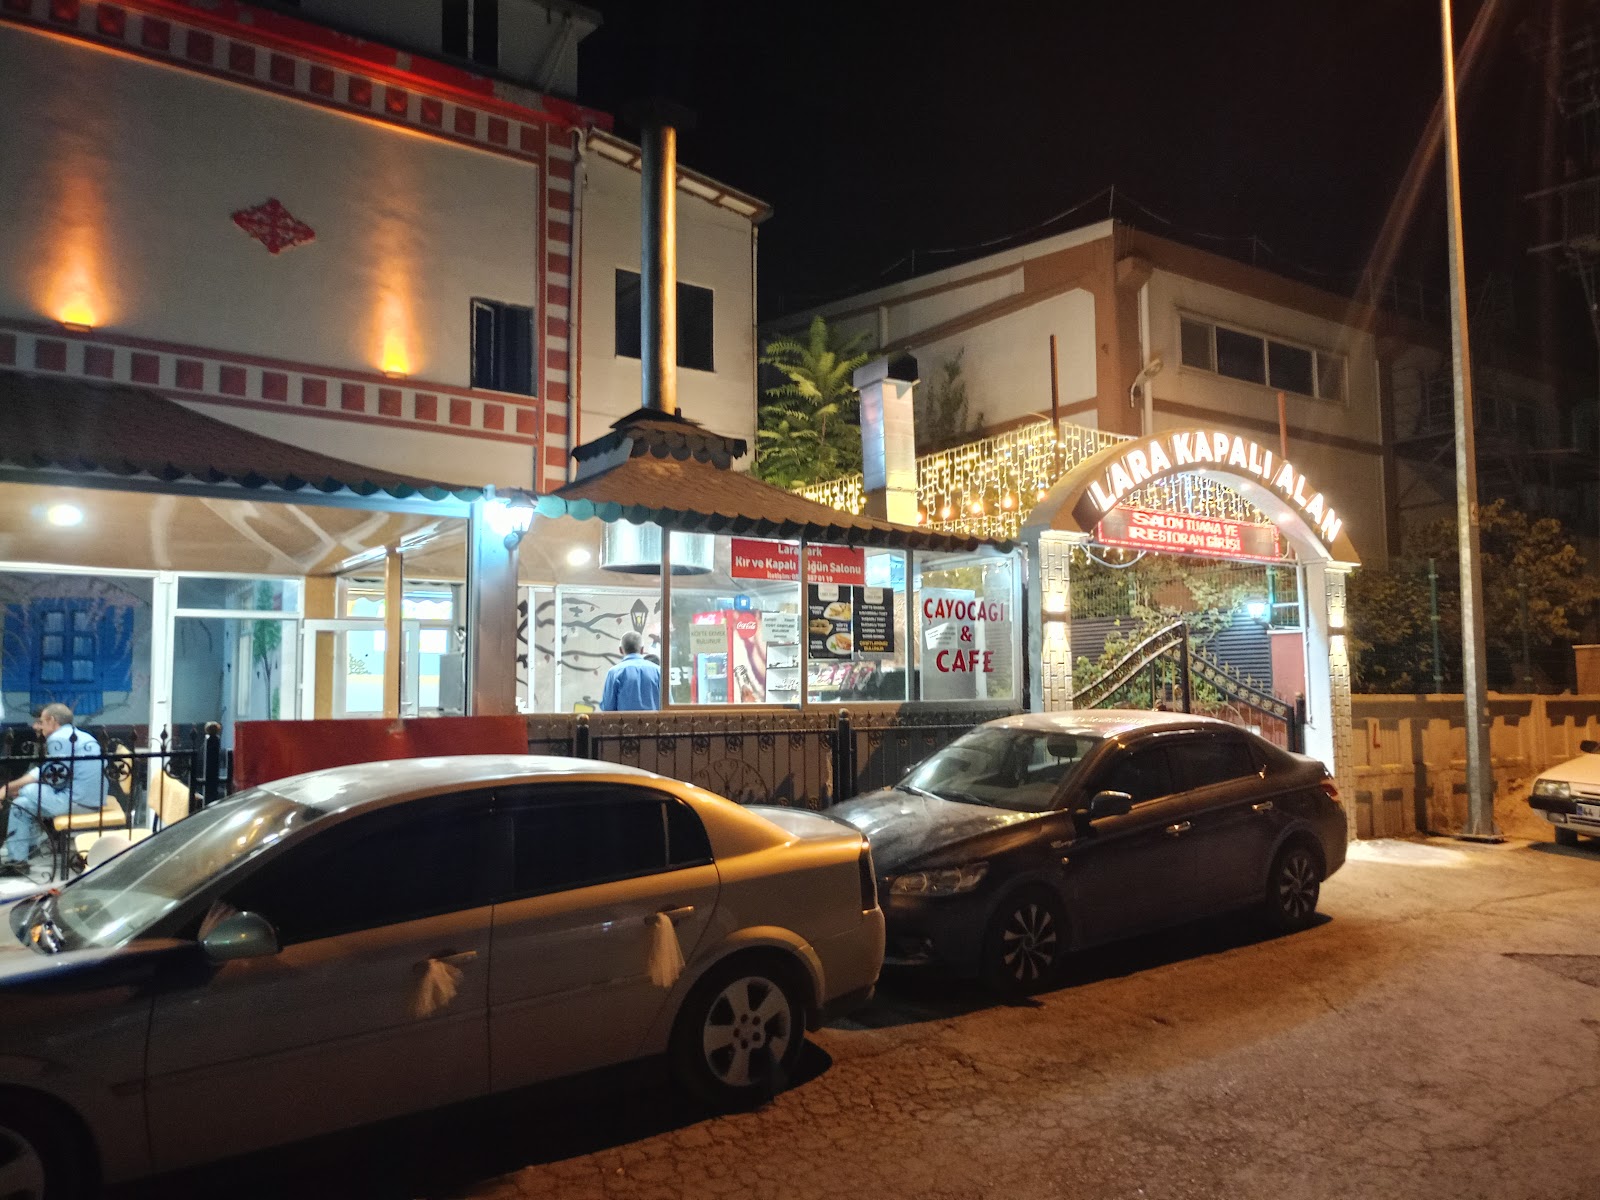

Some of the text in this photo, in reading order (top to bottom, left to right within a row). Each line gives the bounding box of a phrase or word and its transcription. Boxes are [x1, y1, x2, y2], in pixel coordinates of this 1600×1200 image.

[1093, 431, 1343, 543] LARA KAPALI ALAN
[1132, 512, 1184, 529] SALON
[1223, 524, 1239, 537] VE
[1128, 526, 1205, 546] RESTORAN
[778, 544, 823, 557] Lara ark
[752, 559, 764, 569] ve
[765, 557, 796, 572] Kapalı
[829, 562, 861, 574] Salonu
[960, 625, 972, 642] &
[936, 649, 994, 673] CAFE
